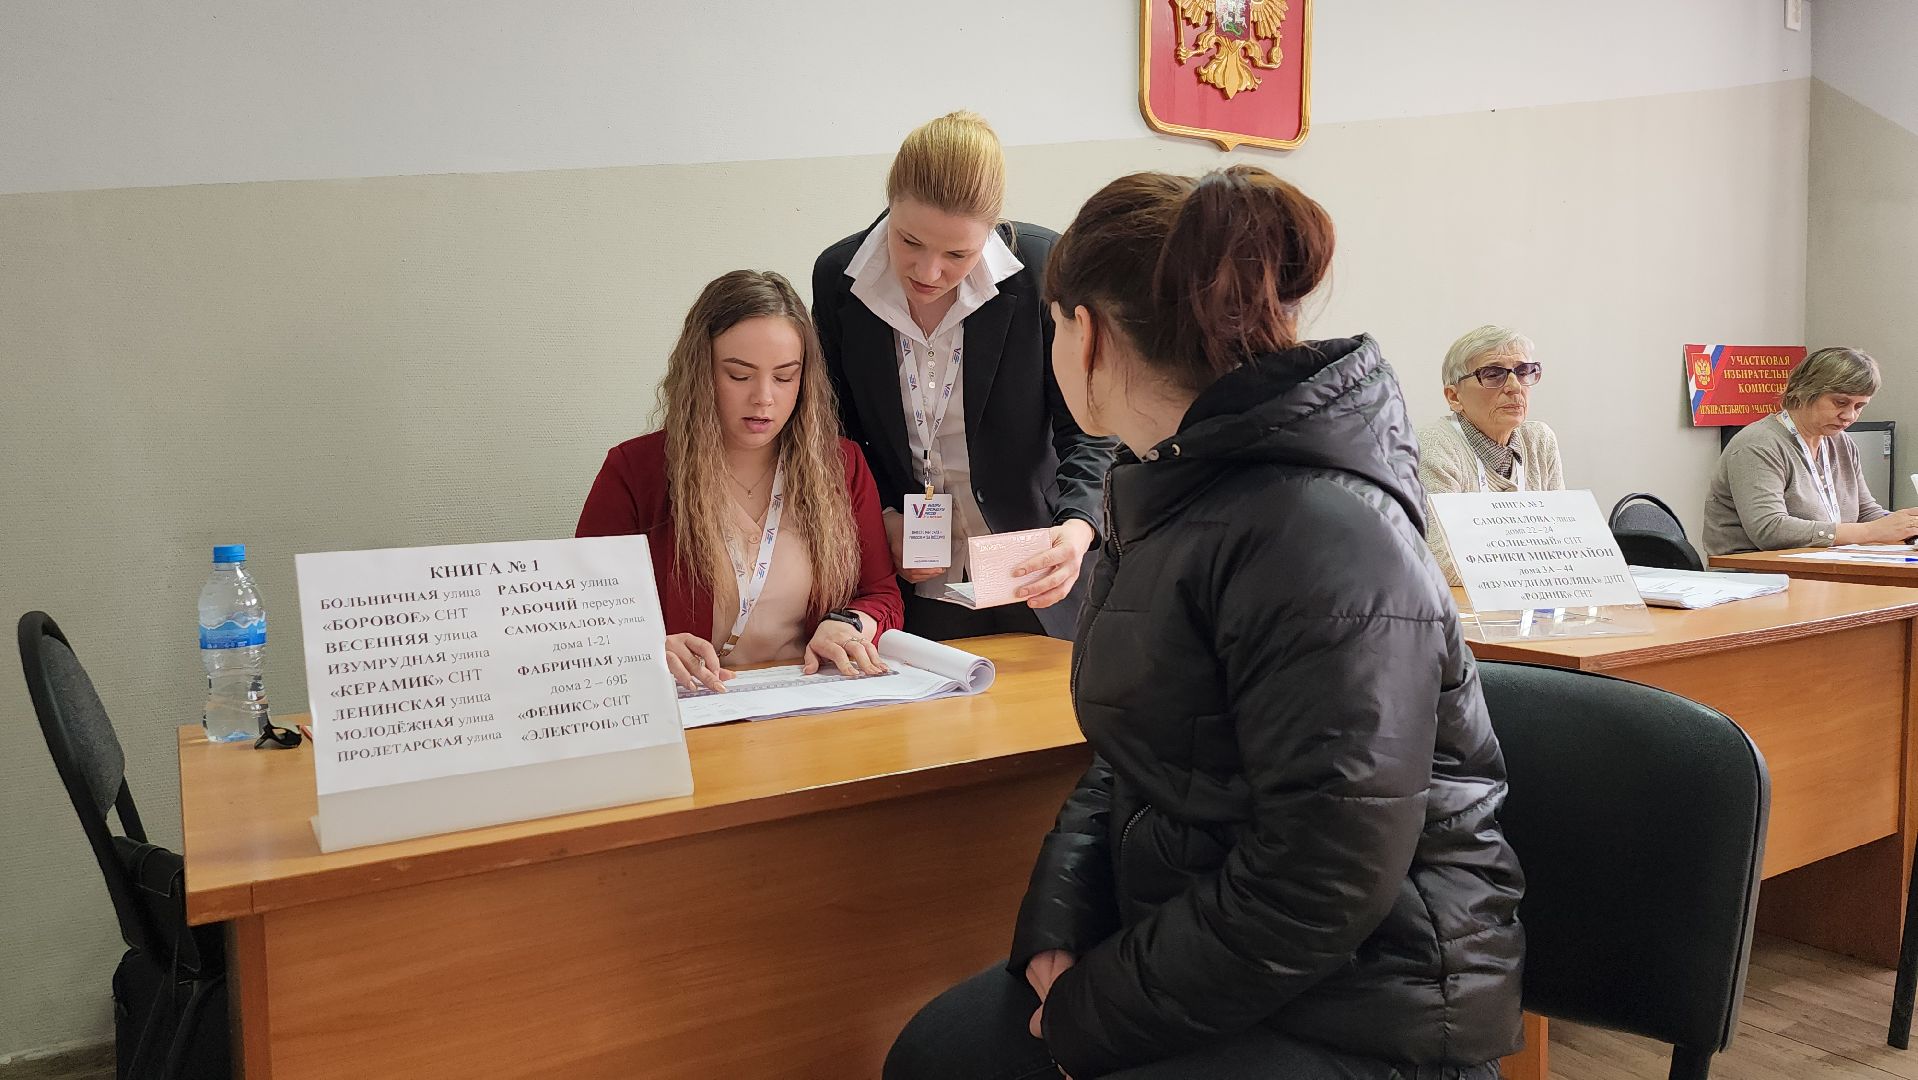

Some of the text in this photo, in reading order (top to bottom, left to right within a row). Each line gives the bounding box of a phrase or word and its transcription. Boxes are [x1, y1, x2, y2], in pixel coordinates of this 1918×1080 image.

[1730, 355, 1790, 366] УЧАСТКОВАЯ
[1723, 370, 1790, 379] ИЗБИРАТЕЛЬН
[1738, 383, 1787, 393] КОМИССИ
[1491, 501, 1525, 509] КНИГА
[1538, 500, 1544, 508] 2
[1473, 516, 1550, 526] САМОХВАЛОВА
[1526, 526, 1537, 534] 22
[1544, 526, 1554, 534] 24
[1486, 536, 1582, 548] «СОЛНЕЧНЫЙ» СНТ
[1466, 548, 1614, 564] ФАБРИКИ МИКРОРАЙОН
[430, 560, 540, 580] КНИГА № 1
[1564, 564, 1574, 572] 44
[498, 577, 619, 596] РАБОЧАЯ улица
[1478, 574, 1625, 590] «ИЗУМРУДНАЯ ПОЛЯНА» ДНП
[320, 588, 481, 610] БОЛЬНИЧНАЯ улица
[1520, 589, 1594, 600] «РОДНИК» СНТ
[500, 595, 636, 616] РАБОЧИЙ переулок
[322, 608, 469, 632] «БОРОВОЕ» СНТ
[504, 615, 646, 636] САМОХВАЛОВА улица
[325, 630, 478, 654] ВЕСЕННЯЯ улица
[552, 634, 612, 652] дома 1-21
[328, 650, 490, 676] ИЗУМРУДНАЯ улица
[518, 653, 652, 676] ФАБРИЧНАЯ улица
[330, 668, 482, 698] «КЕРАМИК» СНТ
[550, 682, 582, 696] дома
[584, 678, 592, 689] 2
[606, 674, 628, 686] 69Б
[332, 692, 492, 722] ЛЕНИНСКАЯ улица
[518, 694, 631, 720] «ФЕНИКС» СНТ
[335, 712, 495, 742] МОЛОДЁЖНАЯ улица
[521, 713, 650, 742] «ЭЛЕКТРОН» СНТ
[337, 731, 503, 763] ПРОЛЕТАРСКАЯ улица
